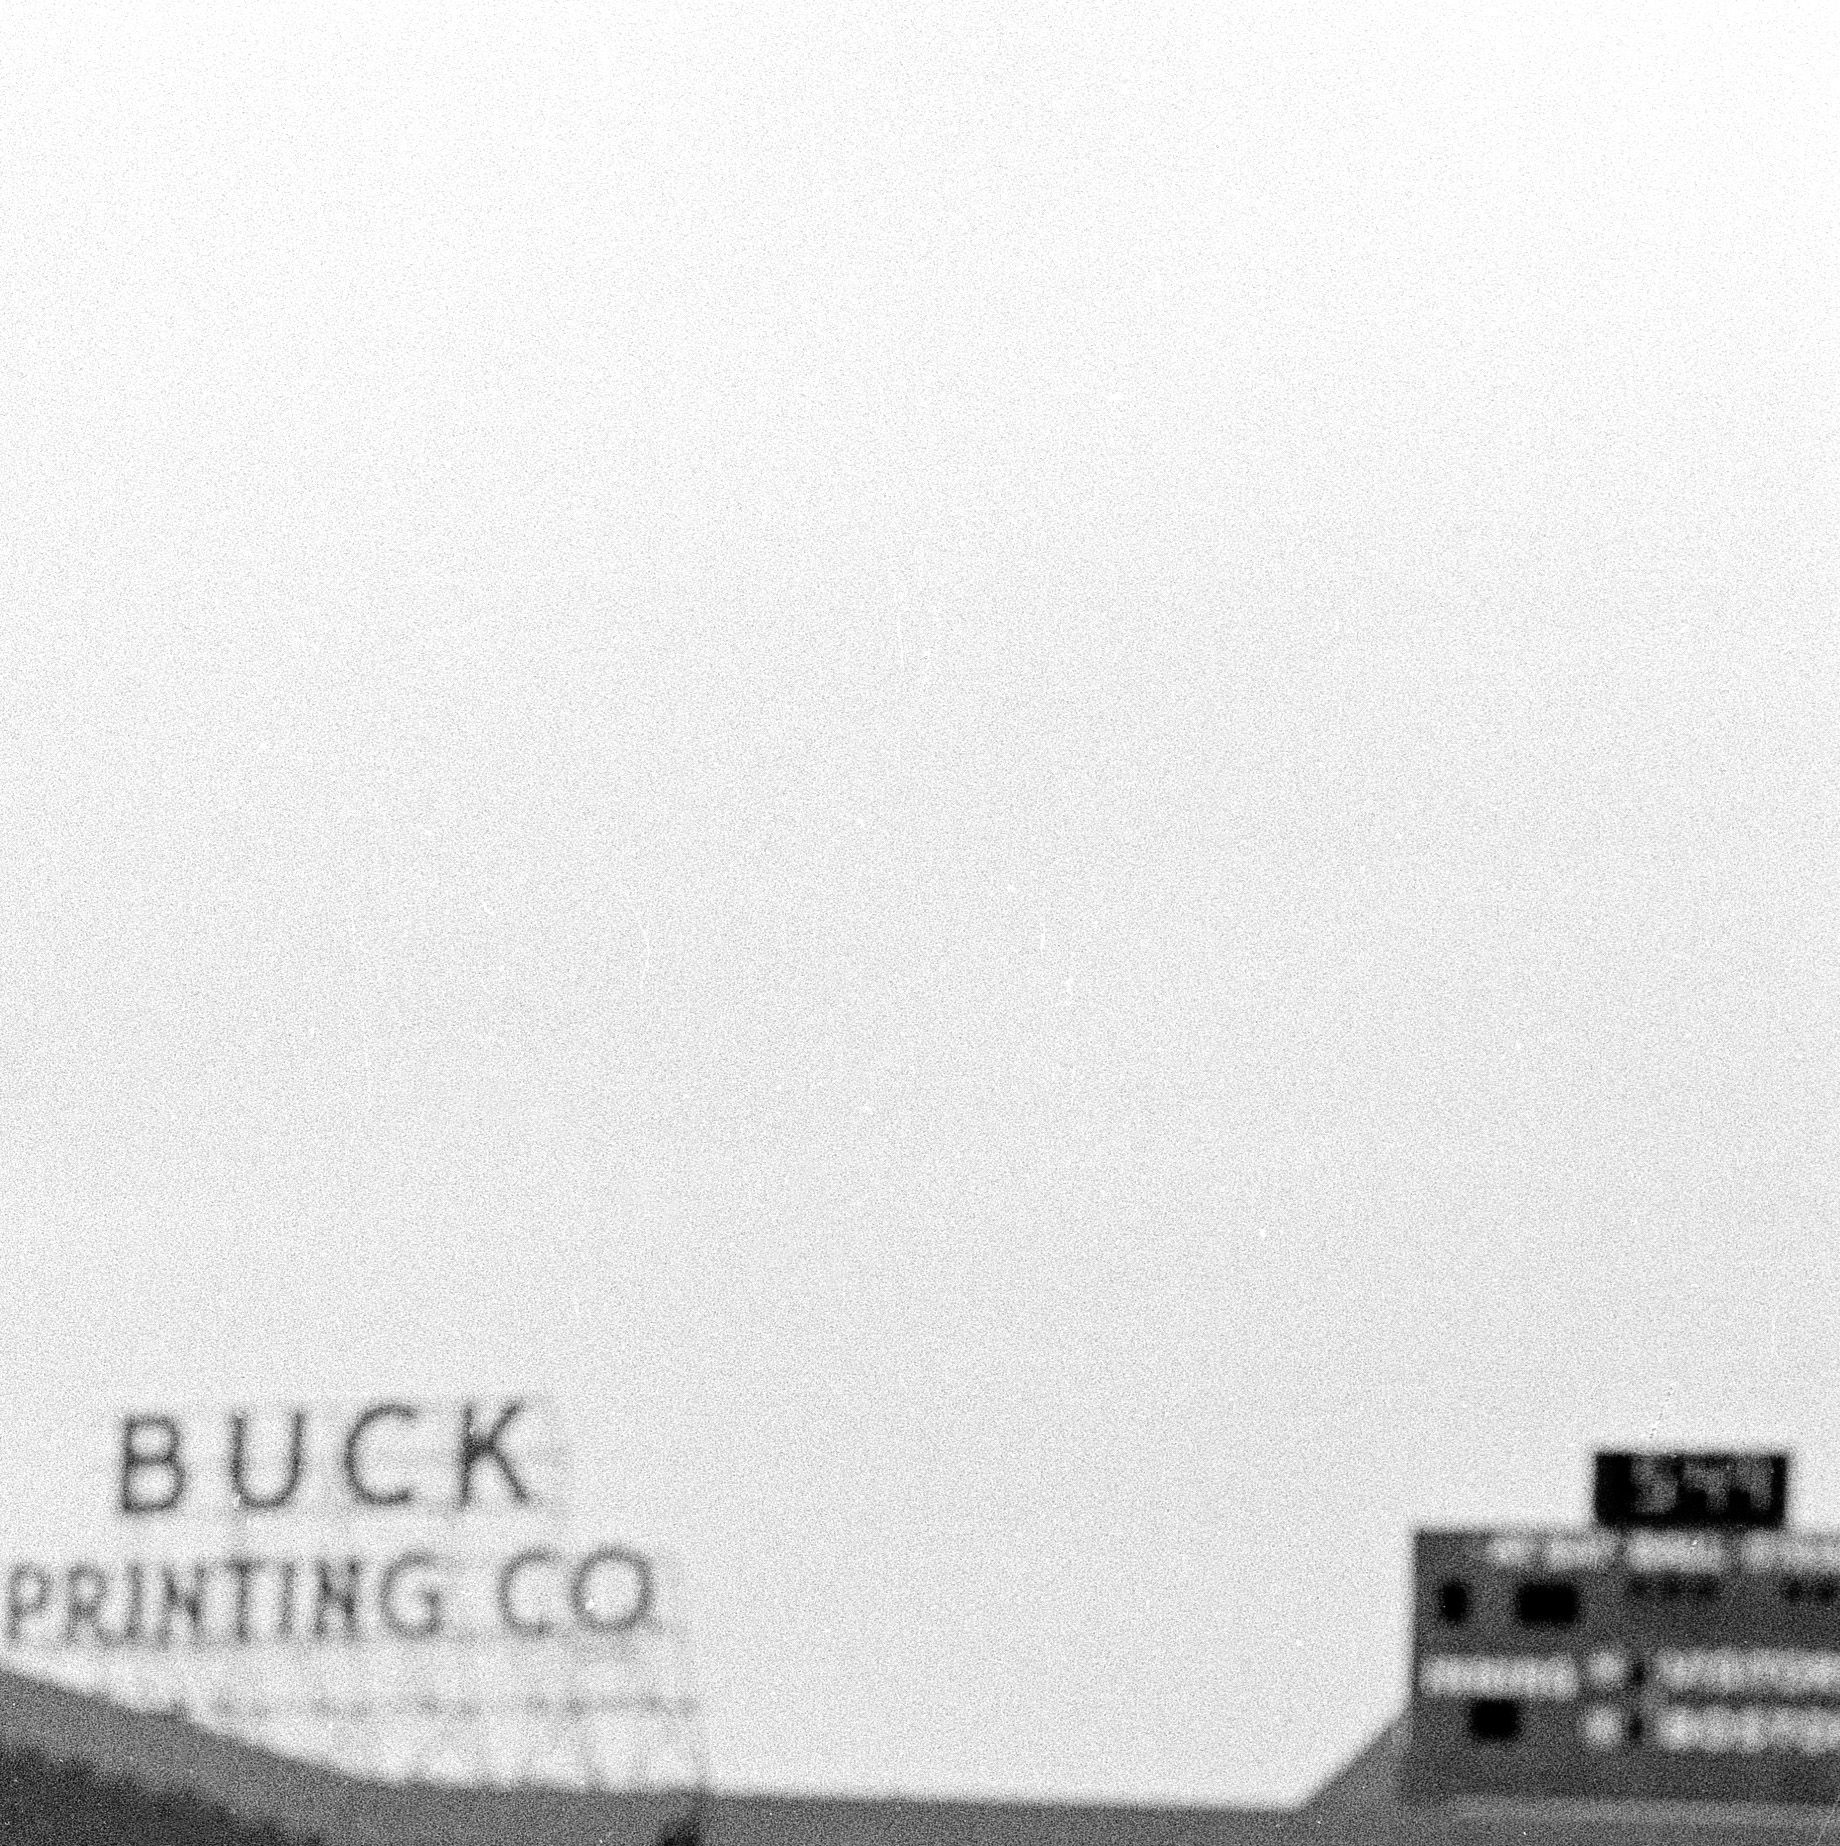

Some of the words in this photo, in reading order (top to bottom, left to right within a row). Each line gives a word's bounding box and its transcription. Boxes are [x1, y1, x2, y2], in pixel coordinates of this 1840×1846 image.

[119, 1399, 536, 1513] BUCK
[4, 1549, 446, 1649] PRINTING
[496, 1545, 656, 1639] CO
